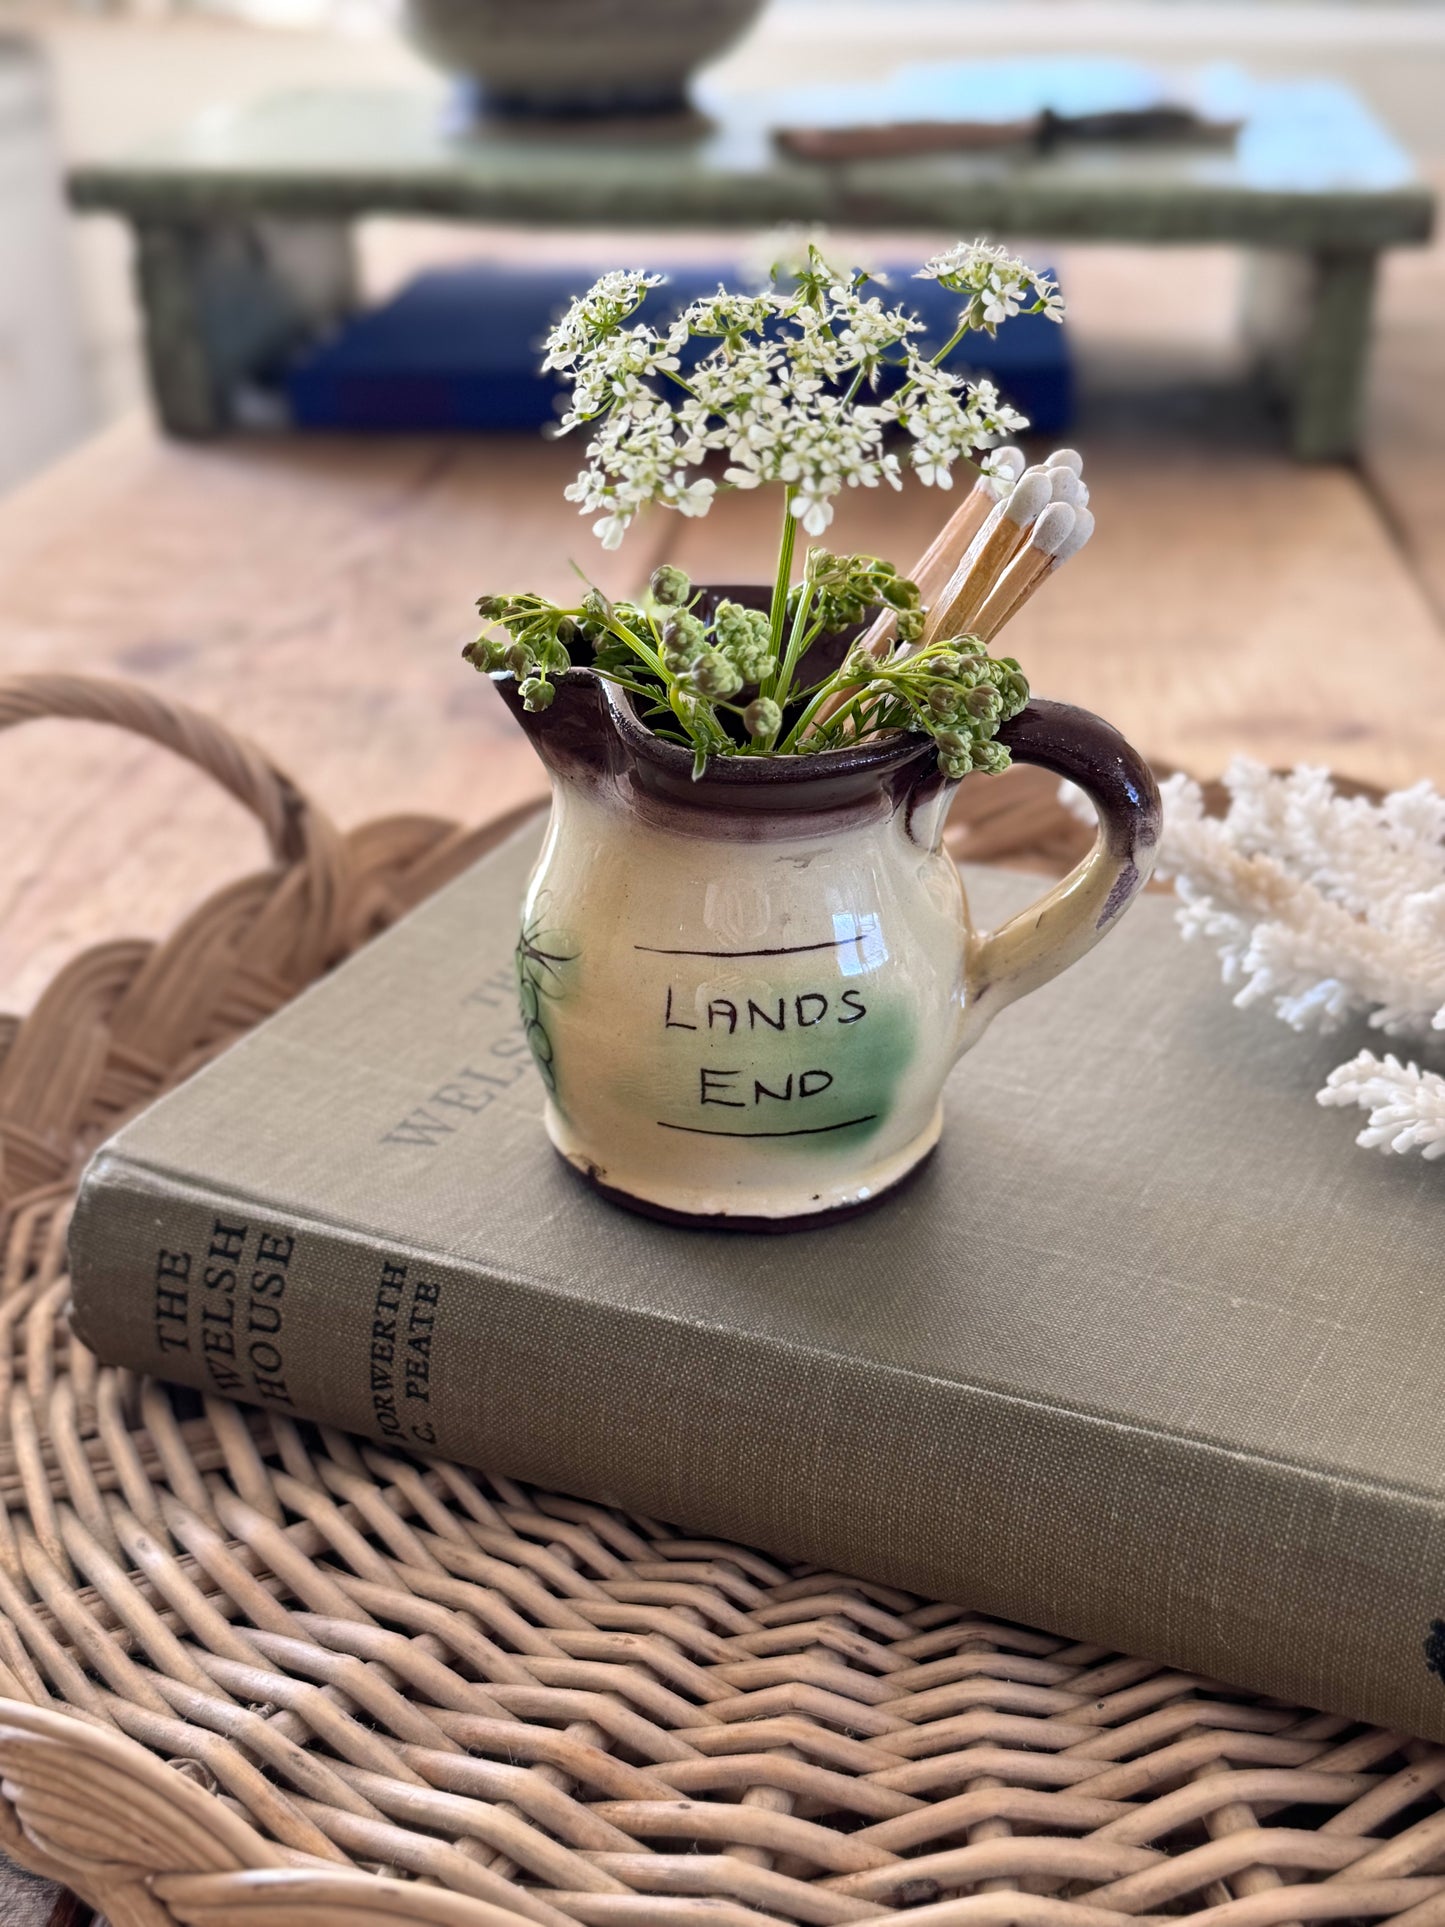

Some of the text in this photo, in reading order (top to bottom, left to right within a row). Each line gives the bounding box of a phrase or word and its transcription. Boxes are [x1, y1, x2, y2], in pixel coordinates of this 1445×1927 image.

[665, 985, 867, 1034] LANDS
[379, 1025, 534, 1147] WELS
[701, 1067, 833, 1107] END
[155, 1249, 192, 1353] THE
[202, 1219, 248, 1392] WELSH
[247, 1233, 295, 1407] HOUSE
[405, 1281, 441, 1445] C. PEATE
